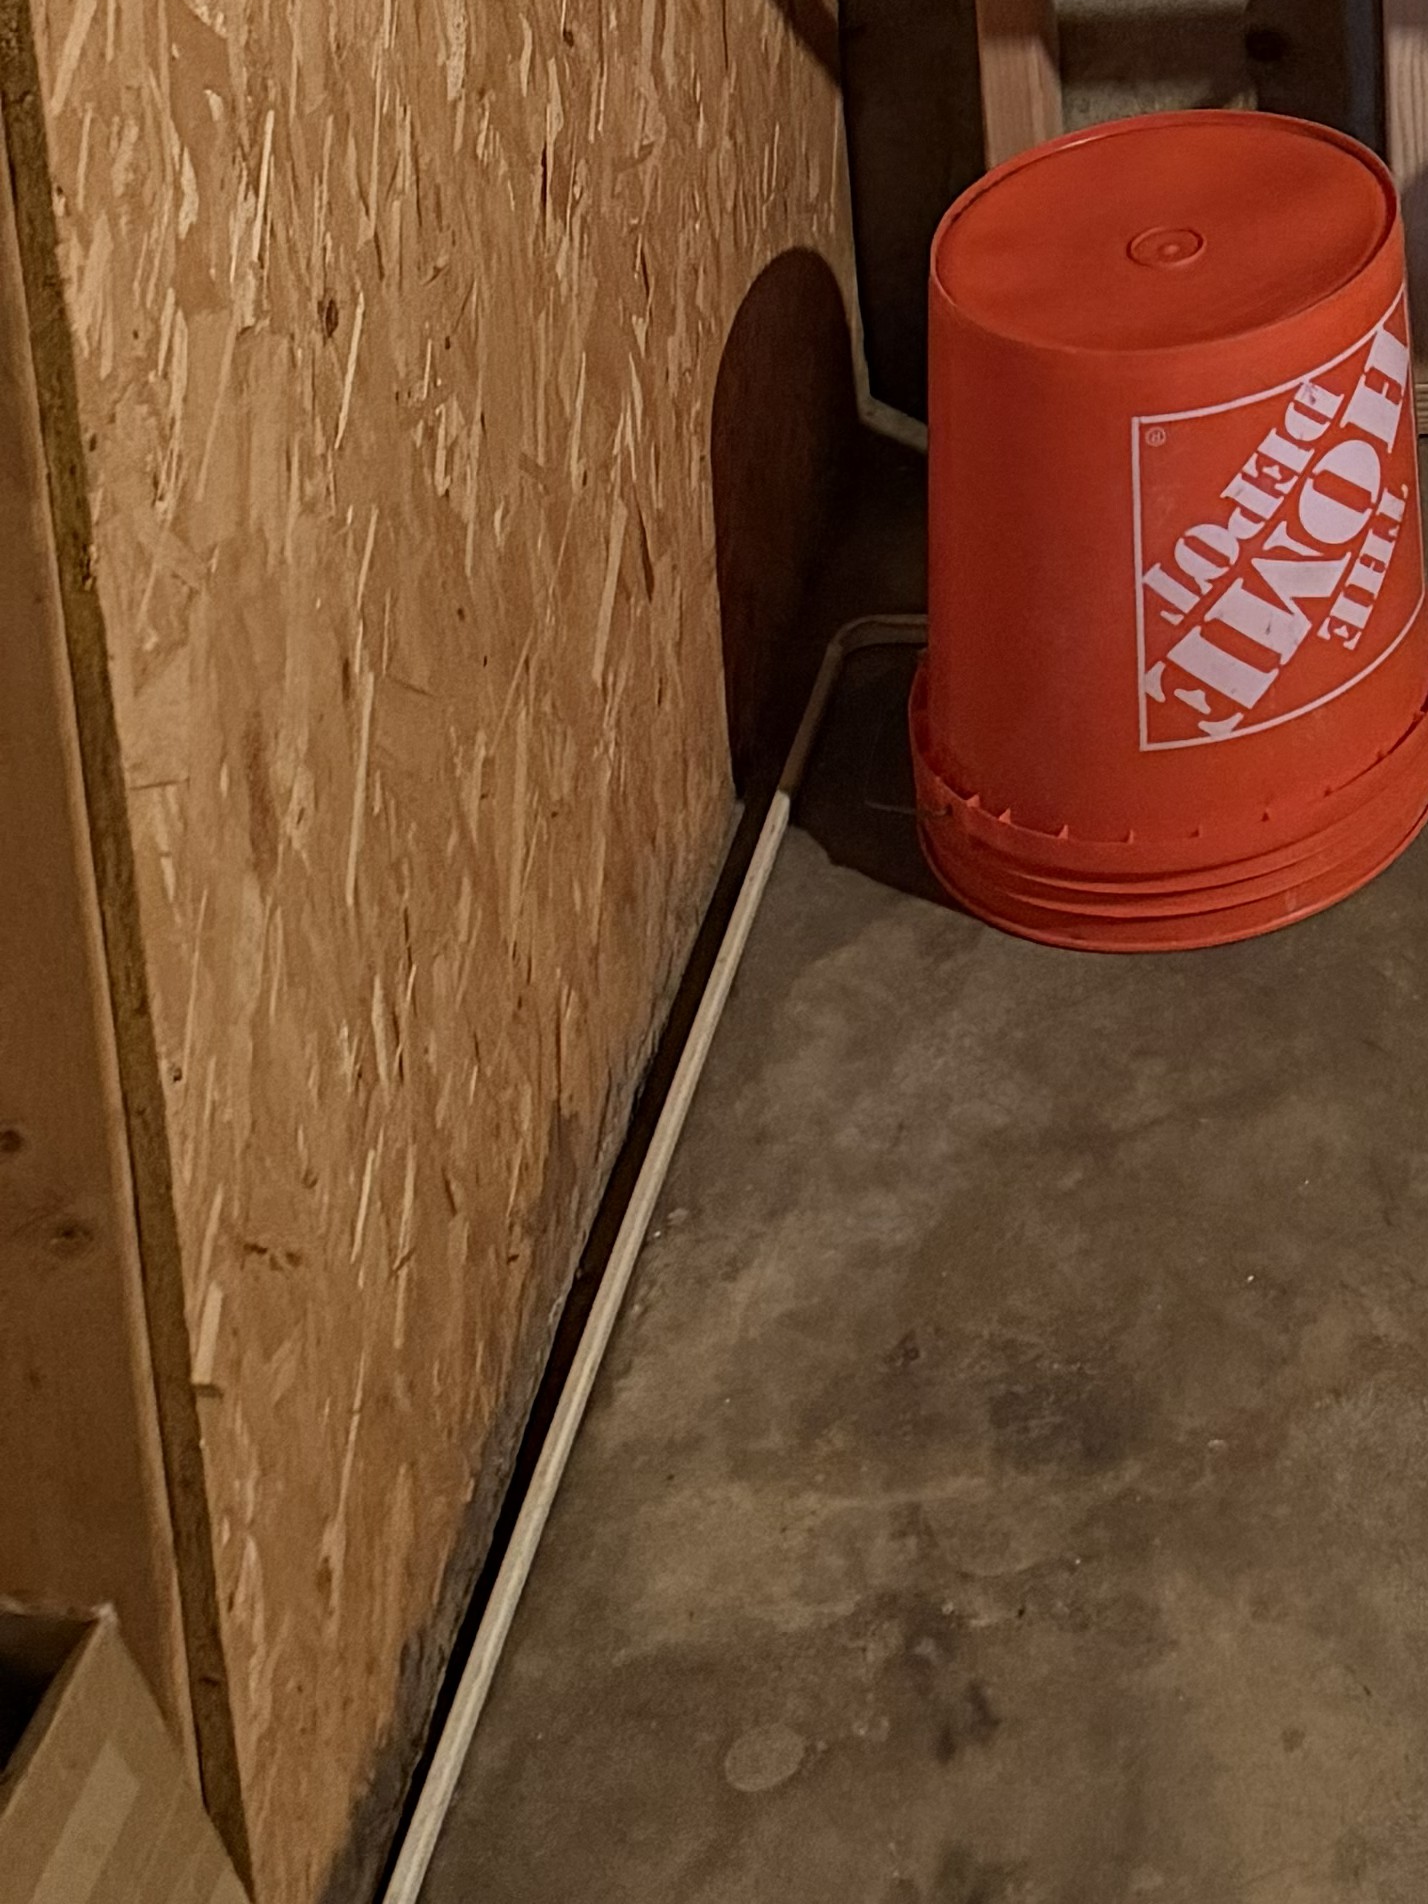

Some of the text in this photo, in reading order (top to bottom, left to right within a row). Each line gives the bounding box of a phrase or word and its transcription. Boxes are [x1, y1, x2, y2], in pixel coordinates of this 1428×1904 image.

[1141, 381, 1346, 626] DEPOT
[1144, 322, 1411, 739] HOME
[1317, 481, 1410, 651] THE
